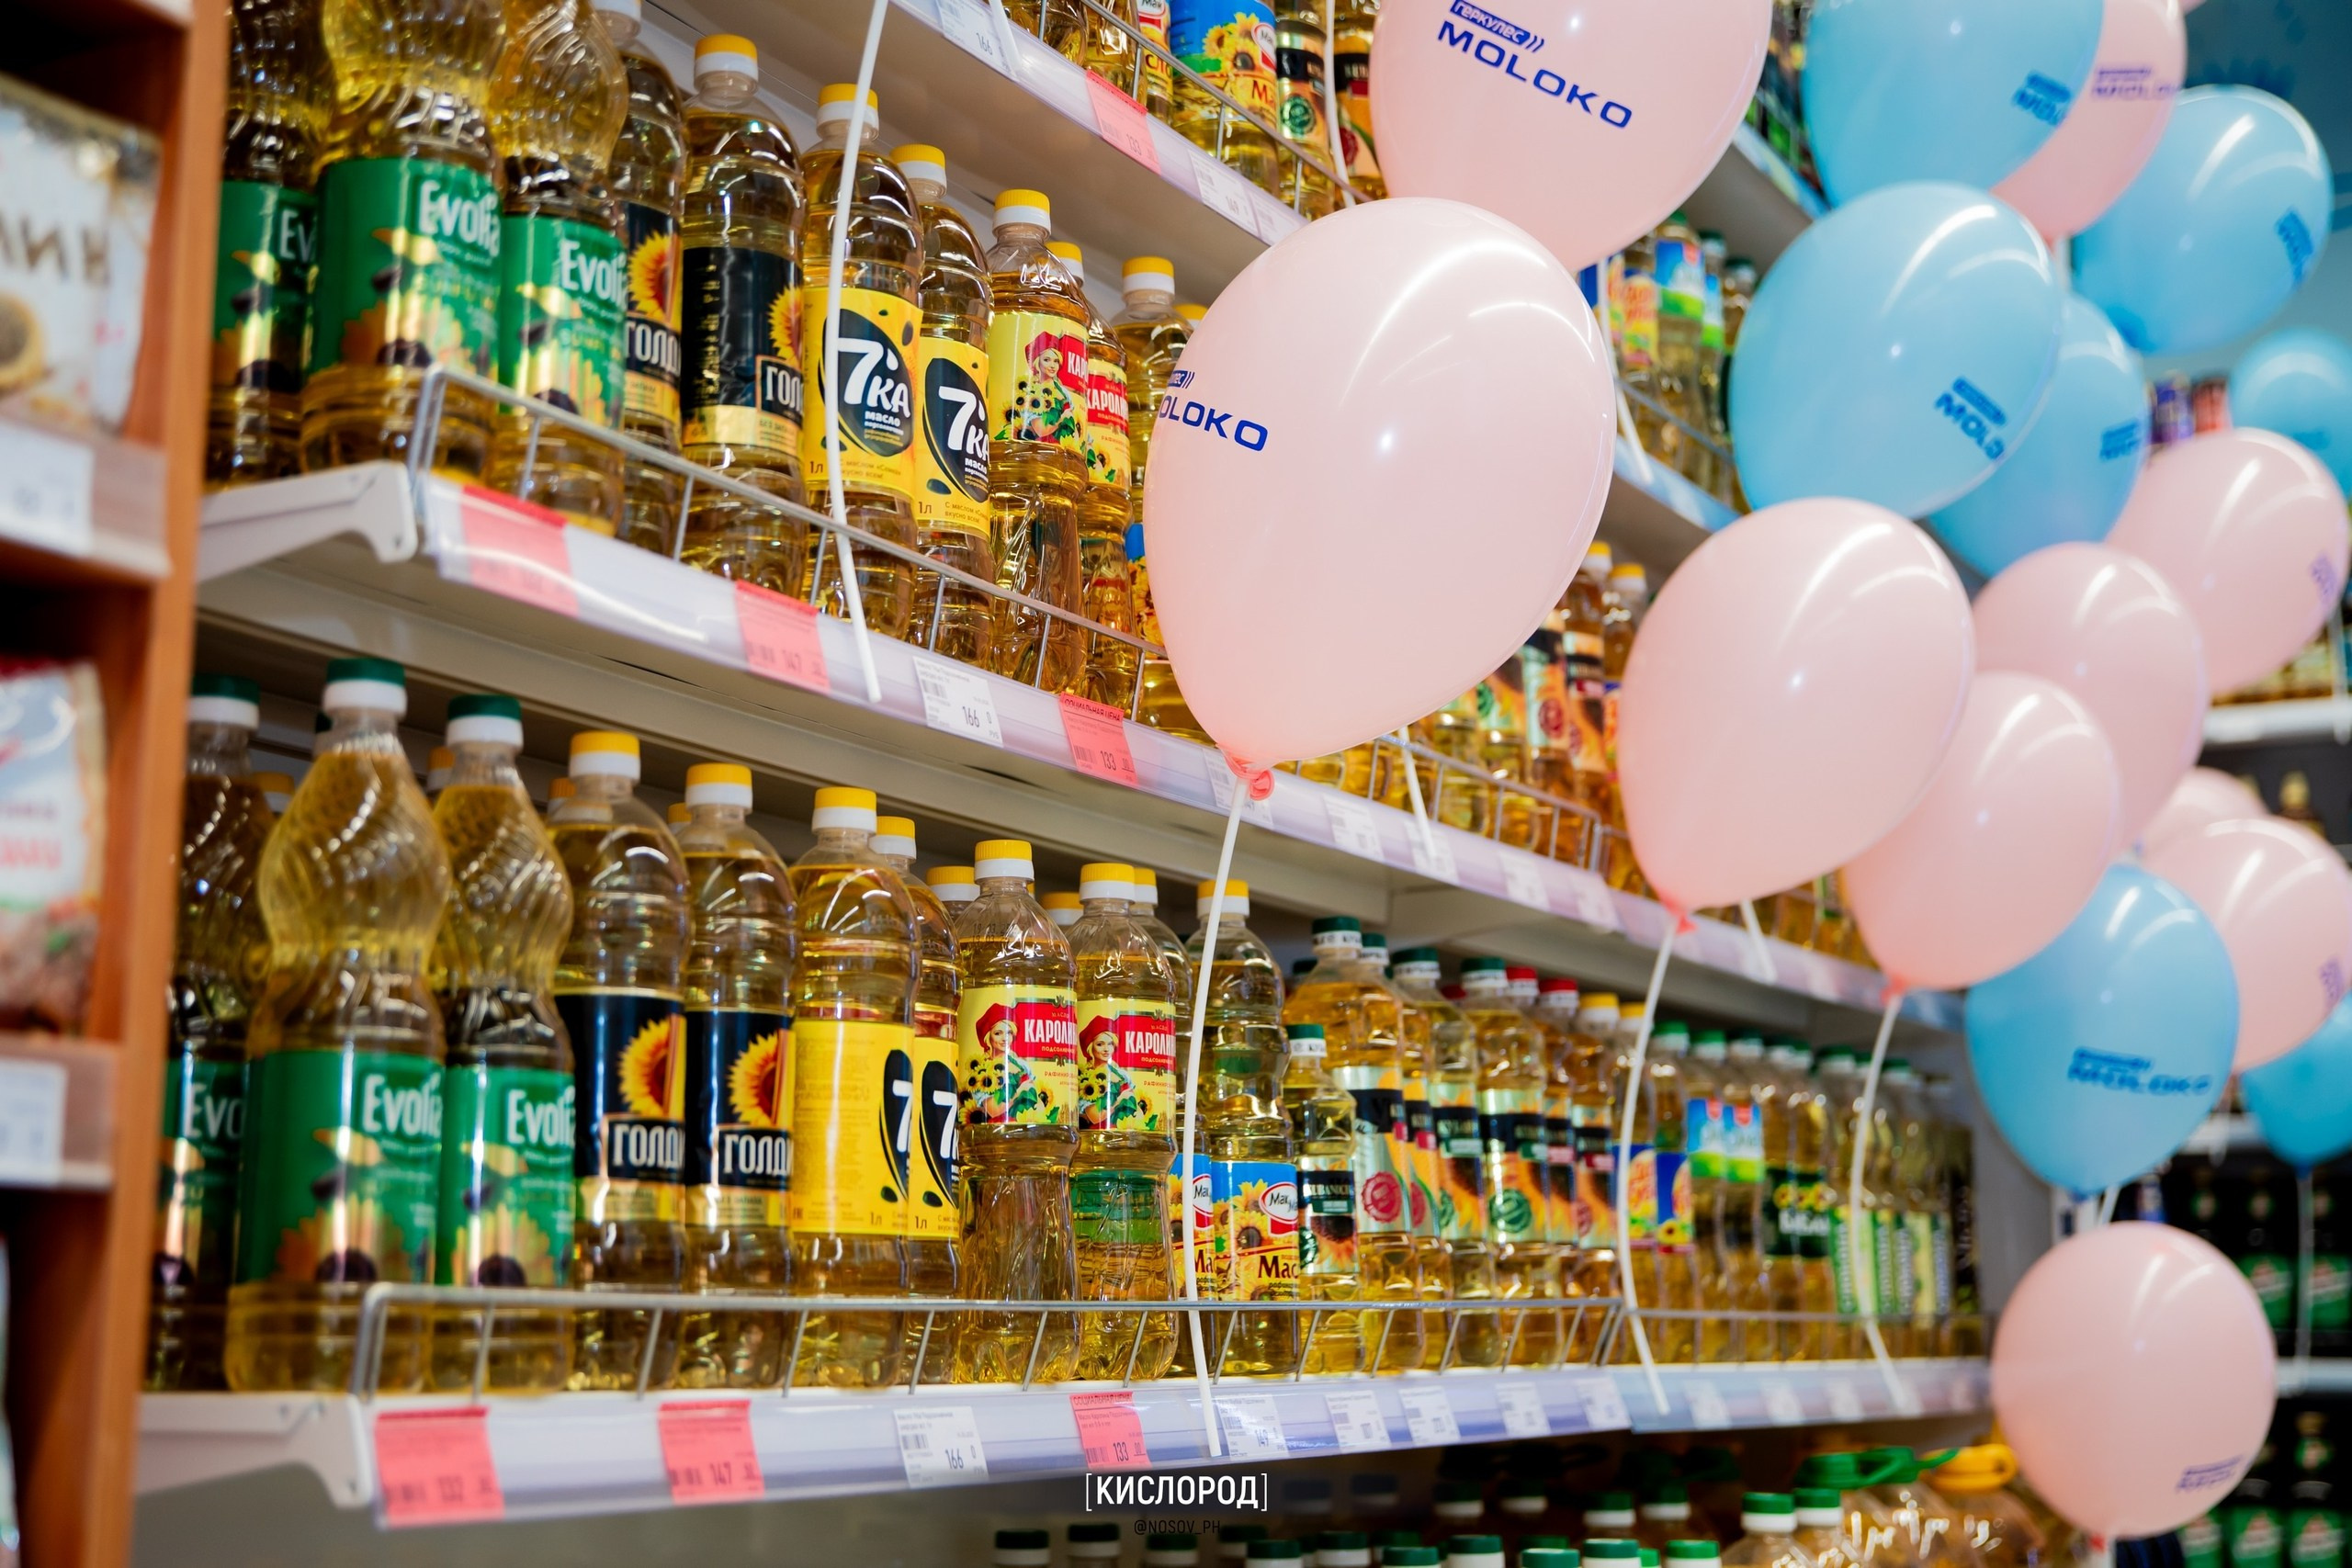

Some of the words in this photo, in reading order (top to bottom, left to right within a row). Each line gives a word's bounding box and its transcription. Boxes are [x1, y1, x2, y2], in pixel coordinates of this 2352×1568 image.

[976, 32, 993, 55] 166
[1438, 20, 1632, 128] MOLOKO
[1159, 394, 1268, 452] OLOKO
[962, 705, 980, 728] 166
[1100, 750, 1117, 772] 133
[945, 1449, 965, 1470] 166
[1113, 1441, 1130, 1463] 133
